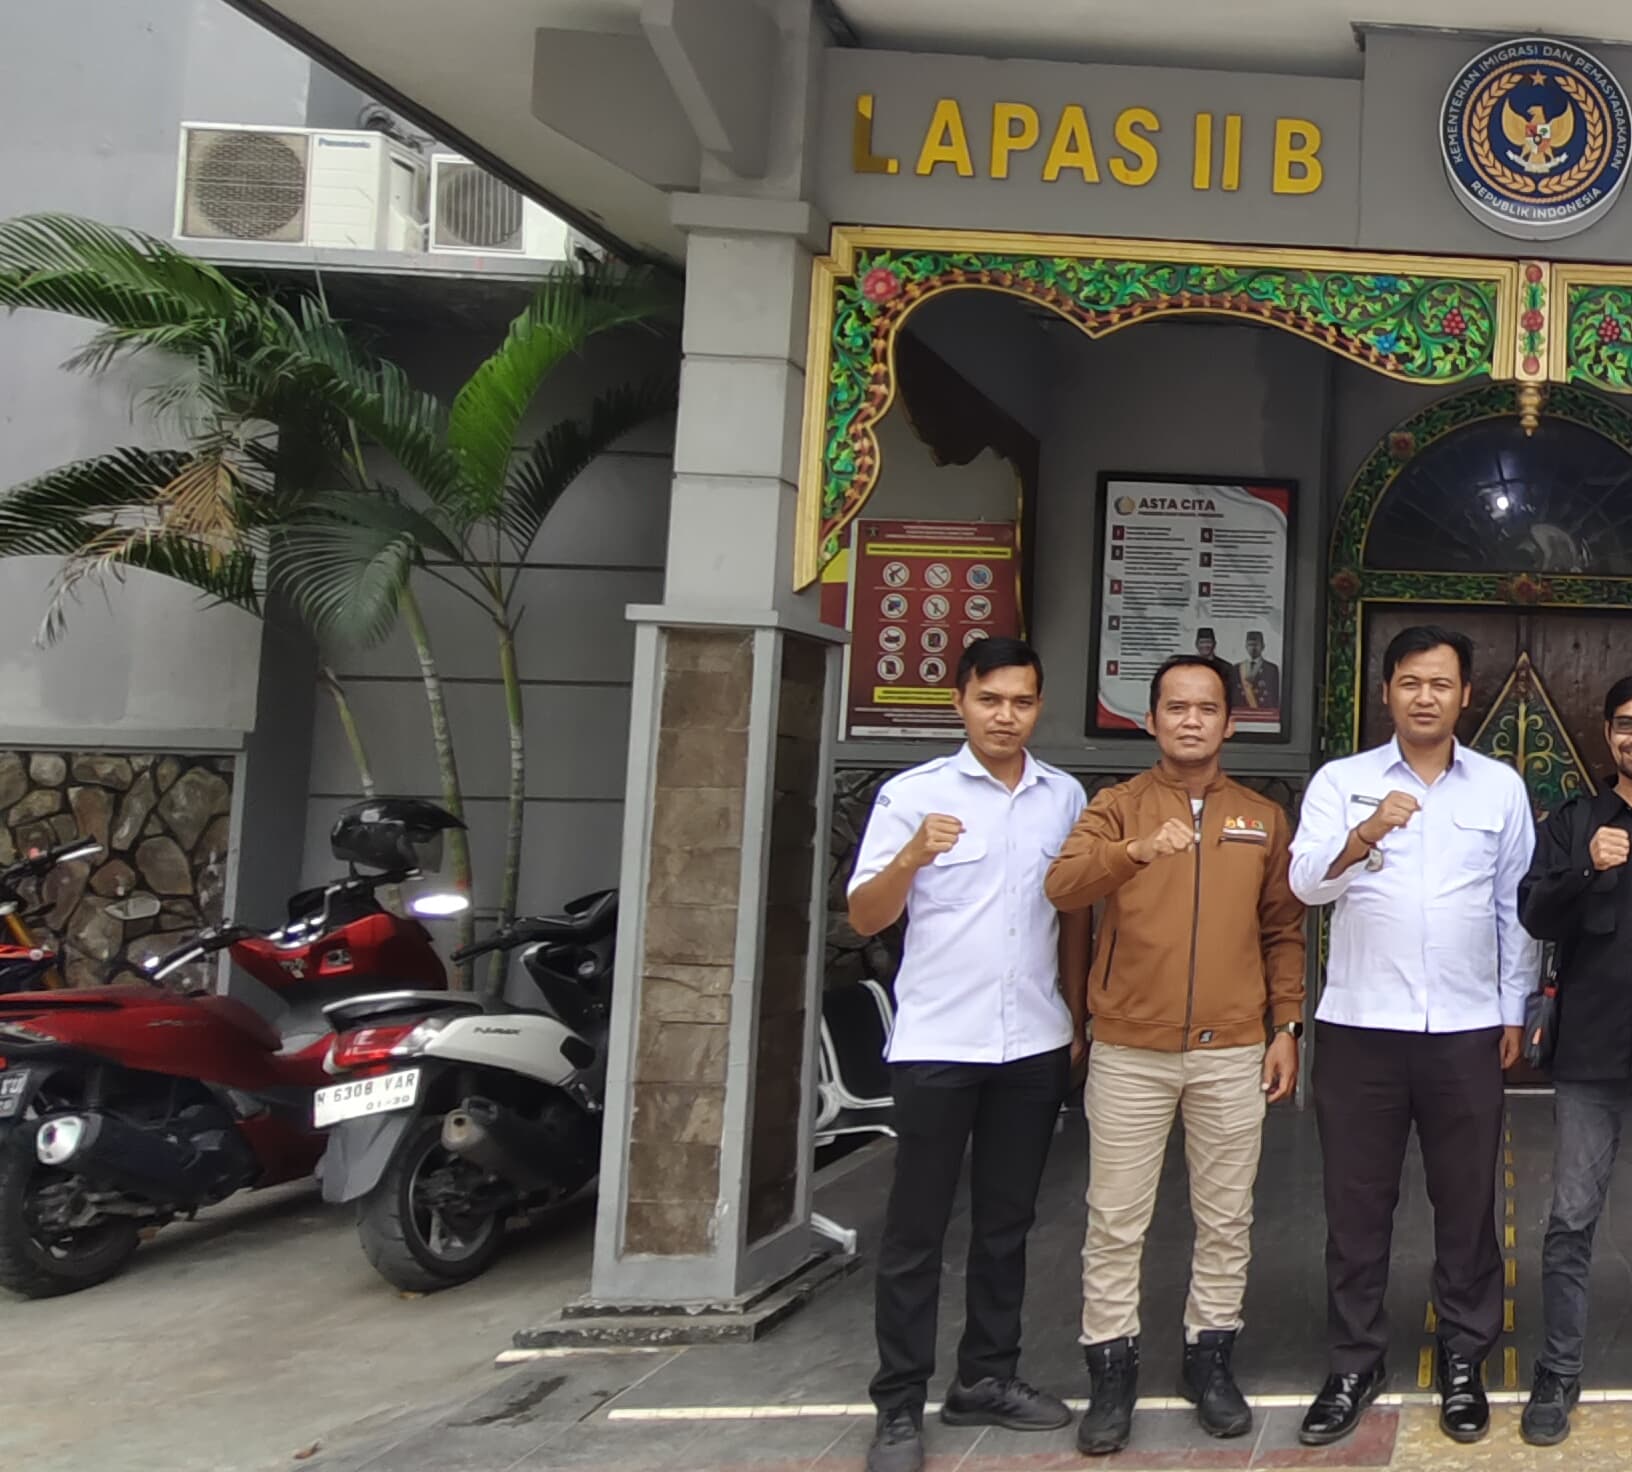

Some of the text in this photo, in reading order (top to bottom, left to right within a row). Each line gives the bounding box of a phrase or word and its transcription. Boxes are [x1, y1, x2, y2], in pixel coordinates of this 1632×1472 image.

[1447, 44, 1629, 170] KEMENTERIAN IMIGRASI DAN PEMASYARAKATAN
[853, 94, 1324, 194] LAPAS II B
[1470, 180, 1602, 219] REPUBLIK INDONESIA
[1138, 497, 1216, 512] ASTA CITA
[384, 1072, 416, 1092] VAR
